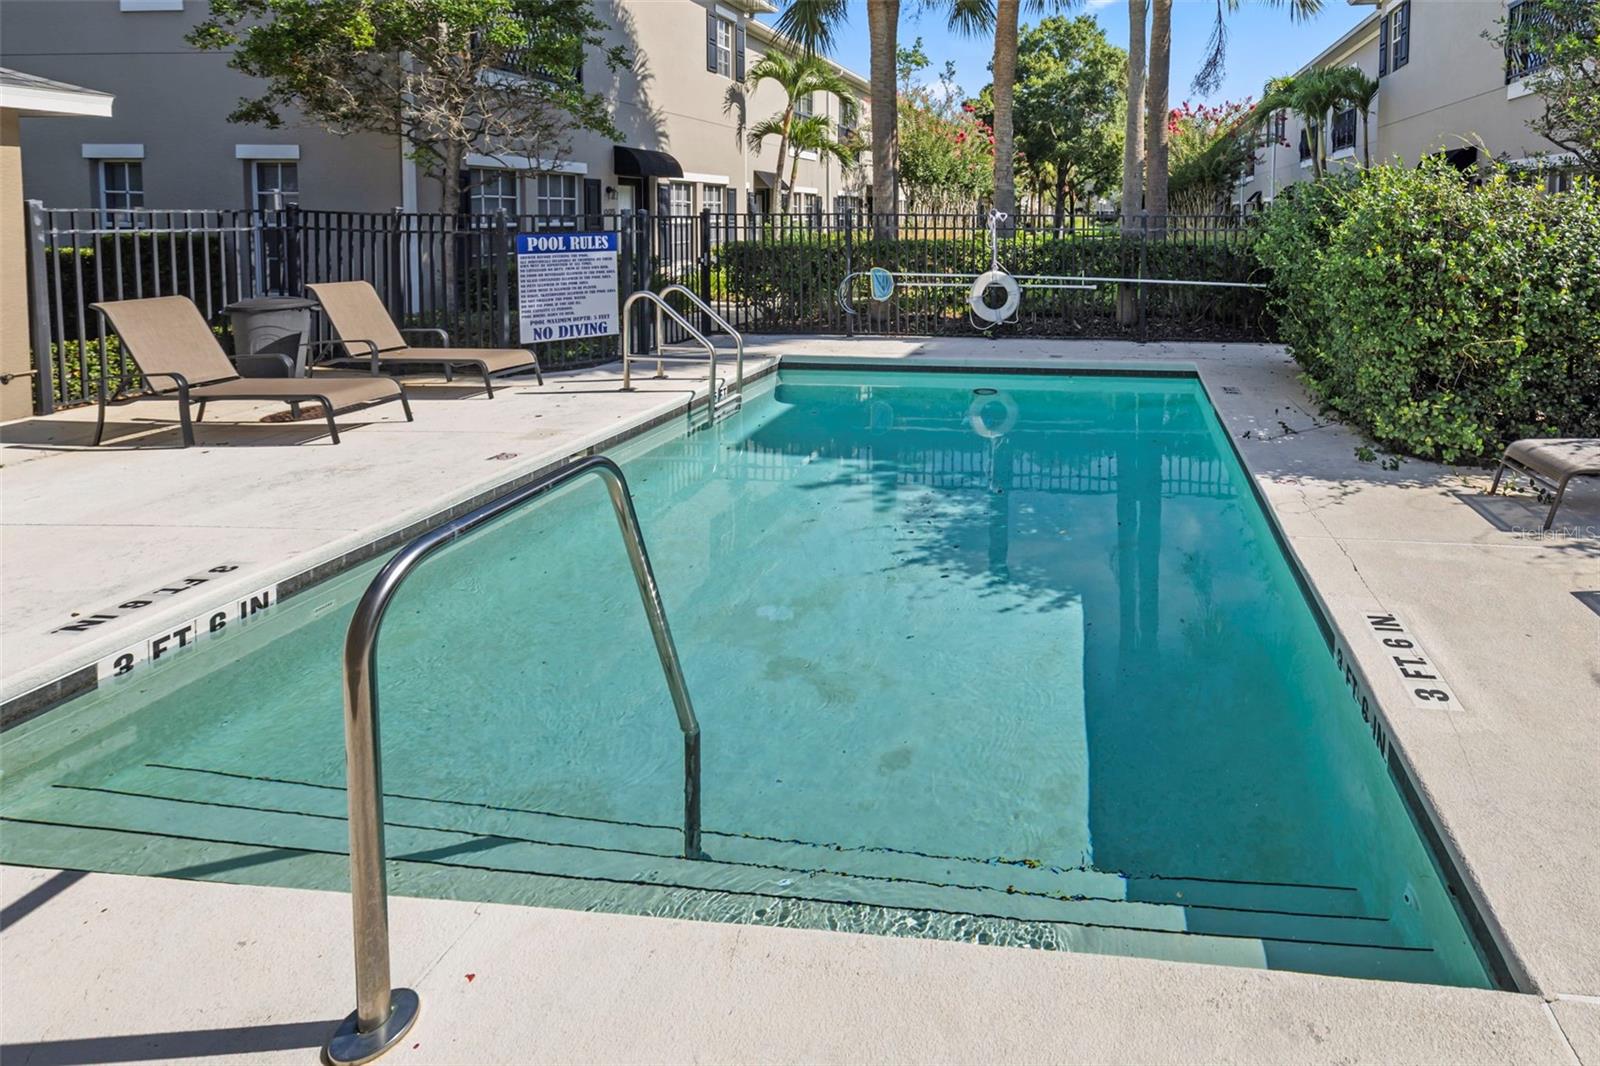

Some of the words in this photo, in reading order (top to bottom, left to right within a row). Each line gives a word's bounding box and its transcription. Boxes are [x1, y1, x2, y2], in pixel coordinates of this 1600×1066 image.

[527, 237, 566, 251] POOL
[570, 235, 609, 250] RULES
[533, 326, 553, 341] NO
[558, 321, 608, 337] DIVING
[118, 599, 153, 609] 6
[1366, 613, 1405, 633] IN.
[113, 653, 135, 677] 3
[209, 611, 226, 634] 6
[1382, 638, 1414, 650] 6
[1393, 656, 1437, 680] FT.
[1414, 688, 1450, 702] 3
[1361, 695, 1370, 723] 6
